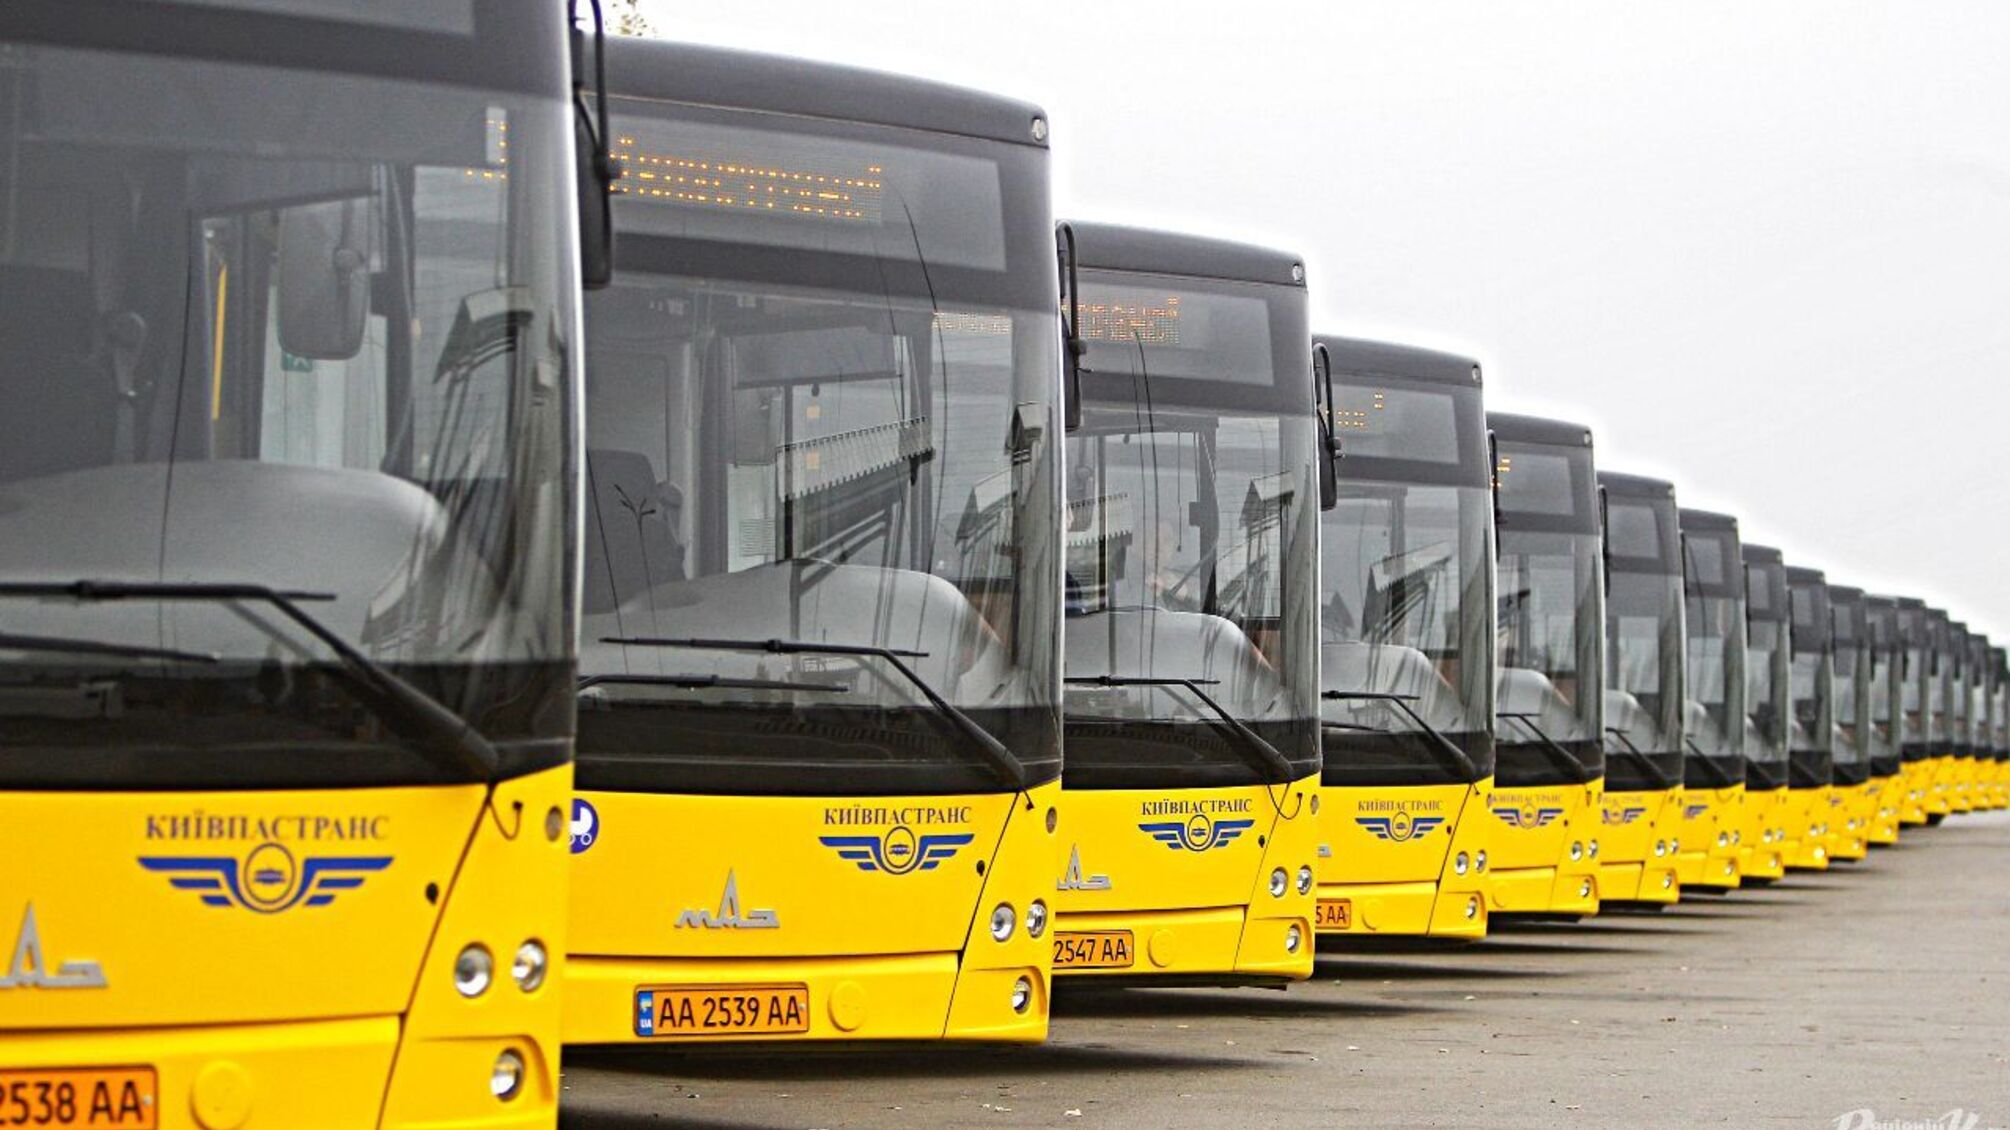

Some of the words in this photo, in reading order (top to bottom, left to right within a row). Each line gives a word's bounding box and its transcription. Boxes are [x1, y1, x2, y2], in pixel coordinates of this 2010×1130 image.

[824, 803, 972, 826] КИЇВПАСТРАНС
[1142, 798, 1253, 816] КИЇВПАСТРАНС
[1357, 799, 1443, 812] КИЇВПАСТРАНС
[146, 809, 390, 841] КИЇВПАСТРАНС
[1327, 905, 1347, 924] AA
[1053, 938, 1096, 963] 2547
[1102, 938, 1127, 961] AA
[659, 997, 696, 1028] AA
[702, 996, 760, 1027] 2539
[767, 995, 801, 1025] AA
[88, 1080, 144, 1124] AA
